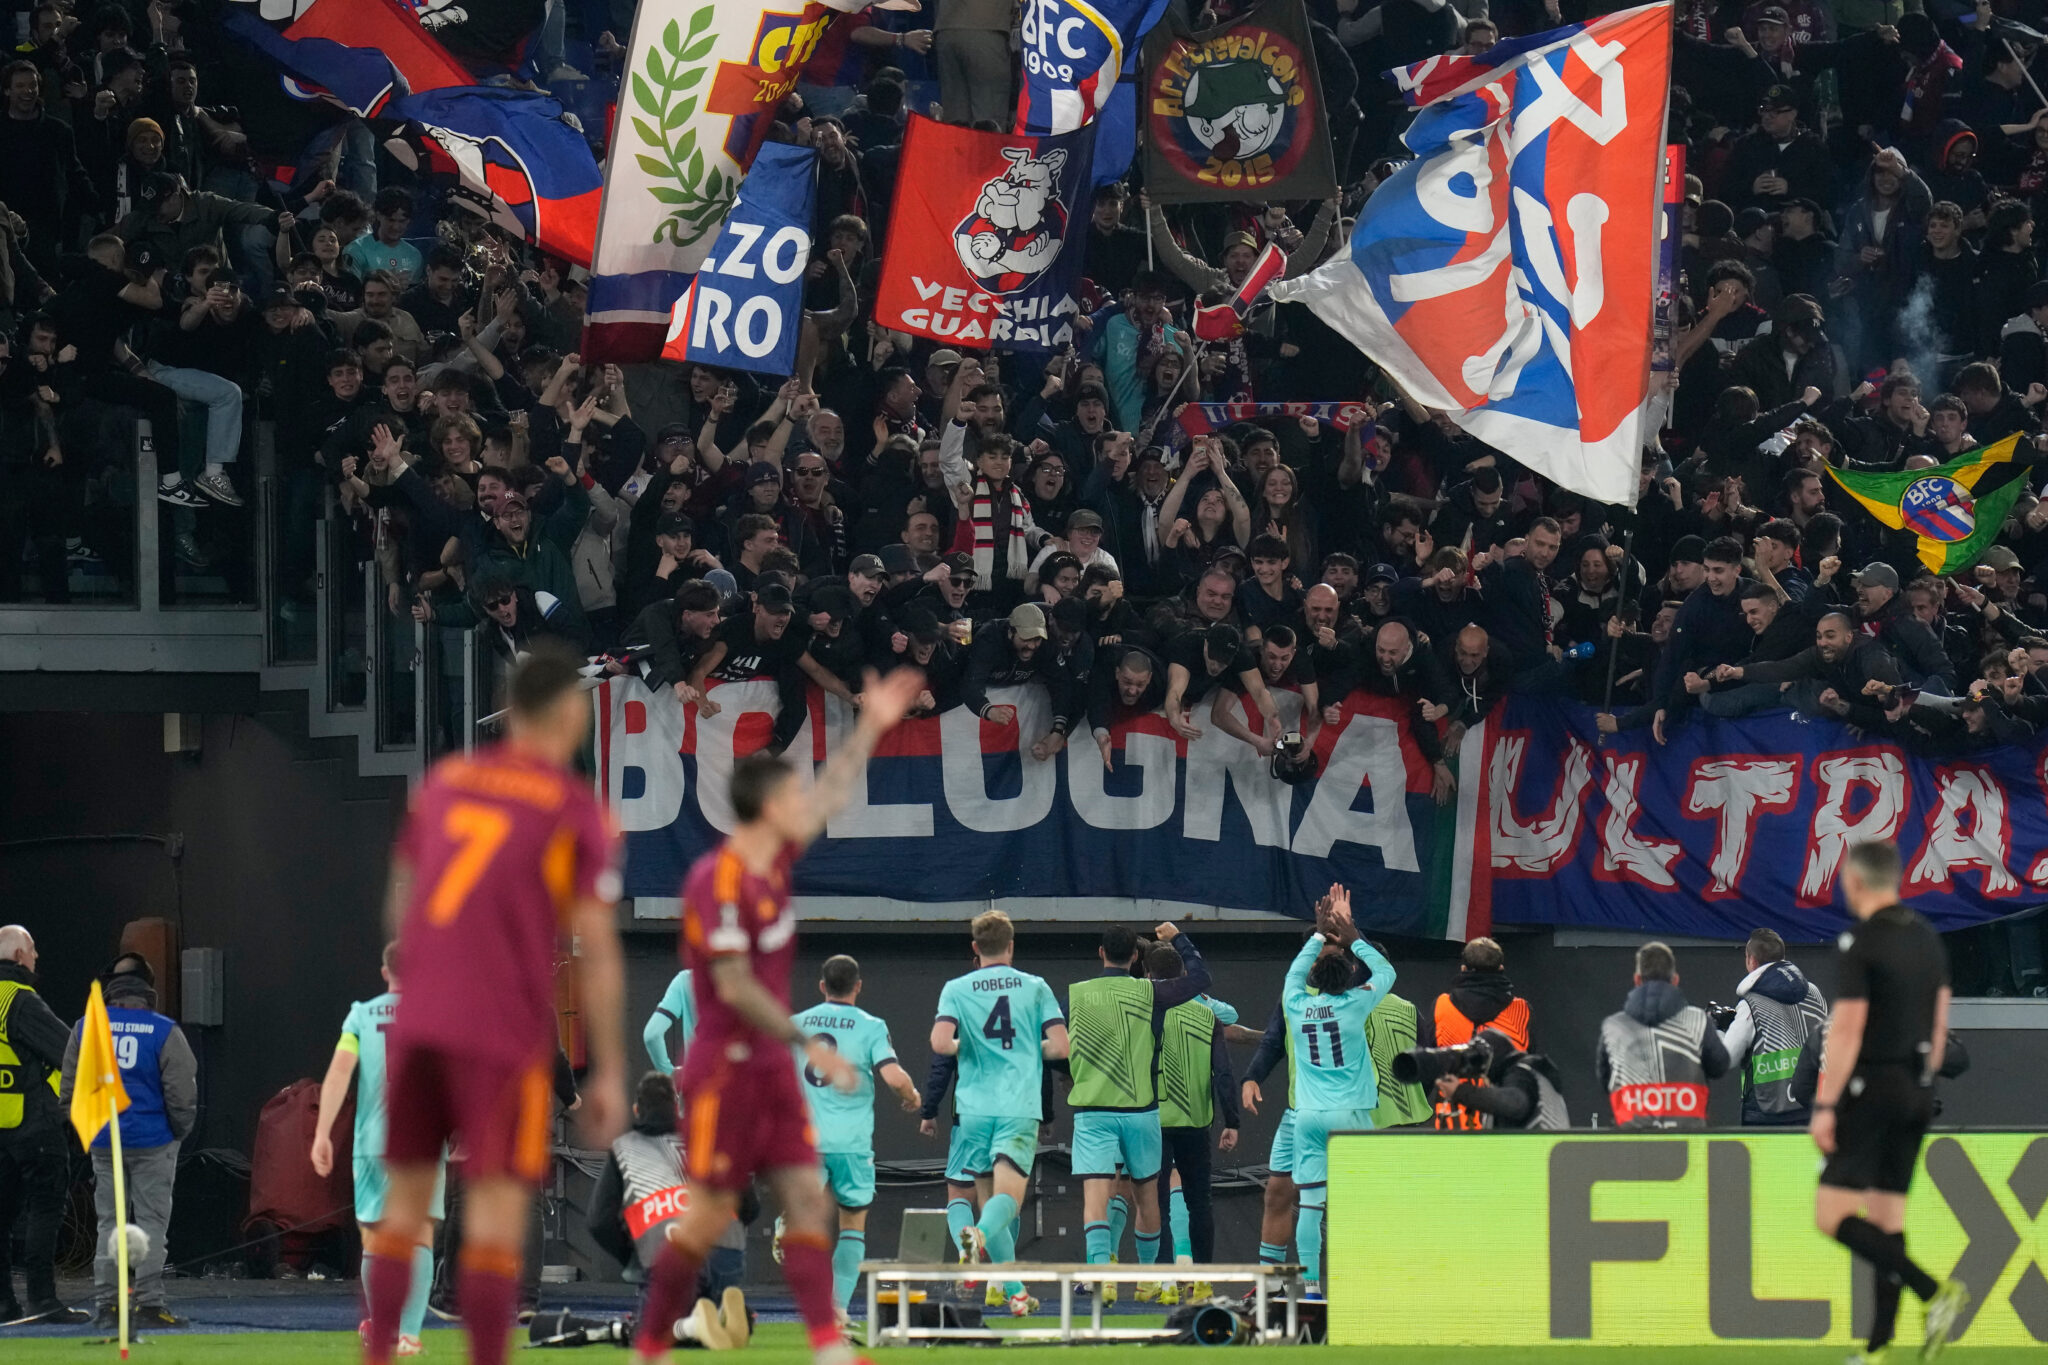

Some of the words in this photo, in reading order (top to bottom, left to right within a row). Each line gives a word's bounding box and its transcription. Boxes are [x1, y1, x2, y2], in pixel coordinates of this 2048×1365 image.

[1023, 47, 1073, 82] 1909
[1197, 153, 1275, 187] 2015
[901, 308, 1073, 347] GUARDIA
[1907, 479, 1943, 505] BFC
[1489, 734, 2048, 898] ULTRA
[428, 803, 512, 925] 7
[972, 977, 1022, 992] POBEGA
[125, 1023, 154, 1034] STADIO
[803, 1015, 855, 1030] FREULER
[983, 995, 1016, 1049] 4
[1306, 1005, 1335, 1019] ROWE
[1302, 1021, 1344, 1068] 11
[1757, 1057, 1790, 1075] CLUB
[1622, 1087, 1697, 1112] HOTO
[643, 1188, 692, 1224] PHO
